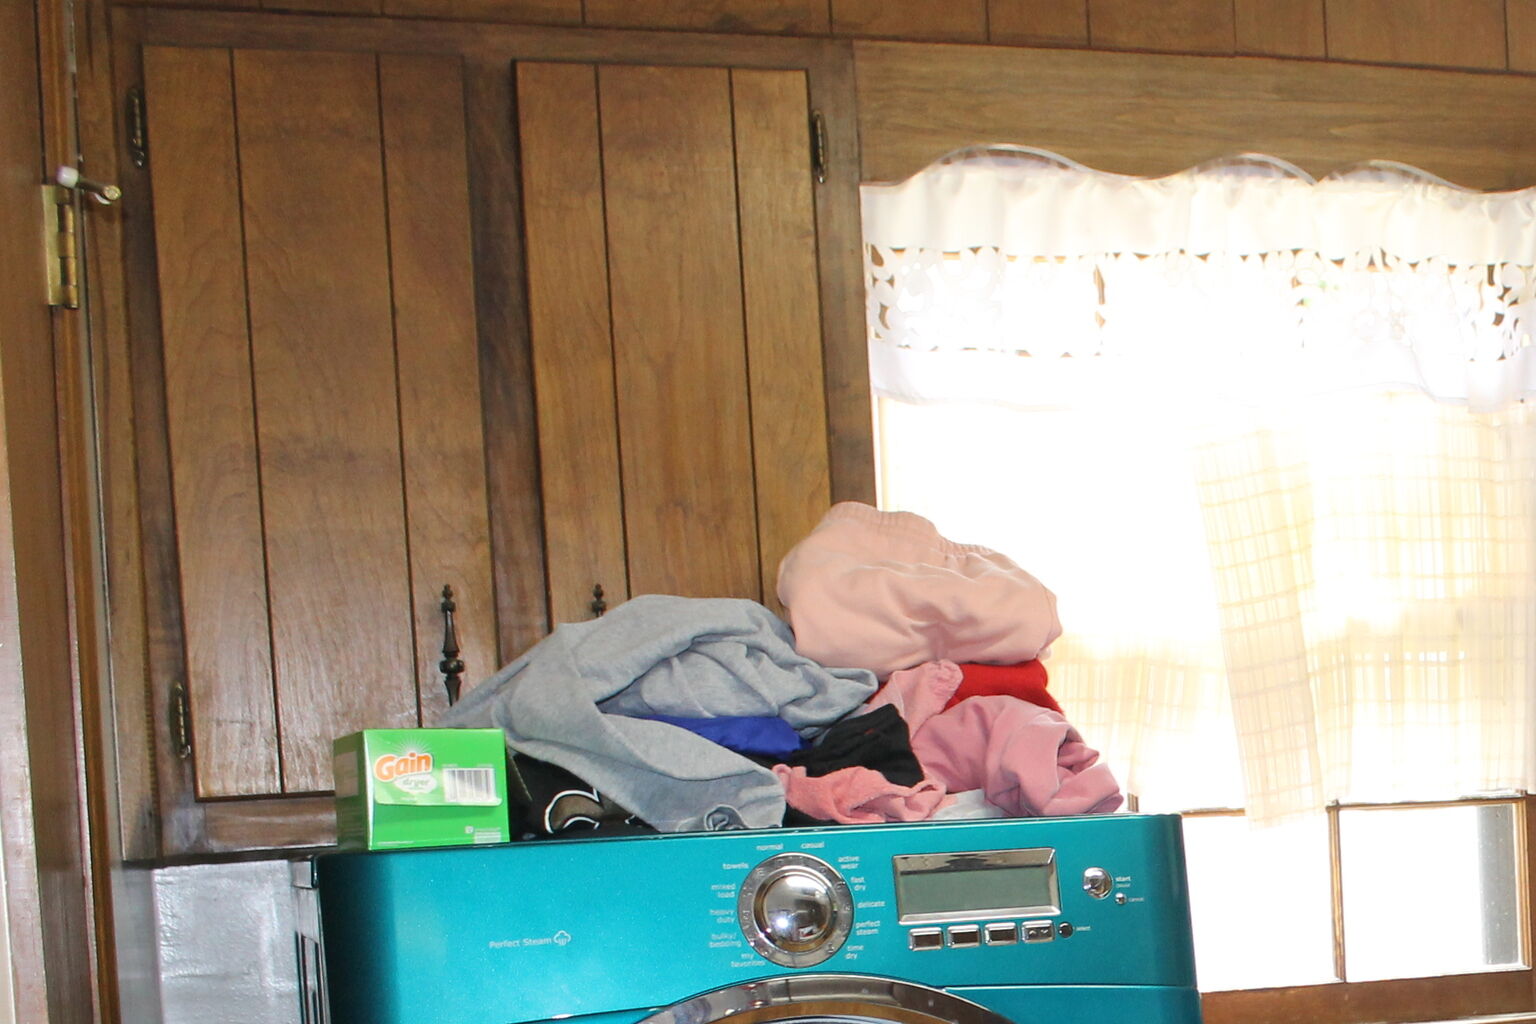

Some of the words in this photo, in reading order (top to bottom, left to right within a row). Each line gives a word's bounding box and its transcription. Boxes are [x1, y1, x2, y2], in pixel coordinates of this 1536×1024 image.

[374, 752, 432, 781] Gain
[402, 777, 431, 788] dryer
[755, 843, 784, 851] normal
[800, 841, 825, 849] casual
[722, 862, 750, 870] towels
[857, 900, 886, 908] delicate
[709, 908, 735, 917] heavy
[716, 916, 736, 925] duty
